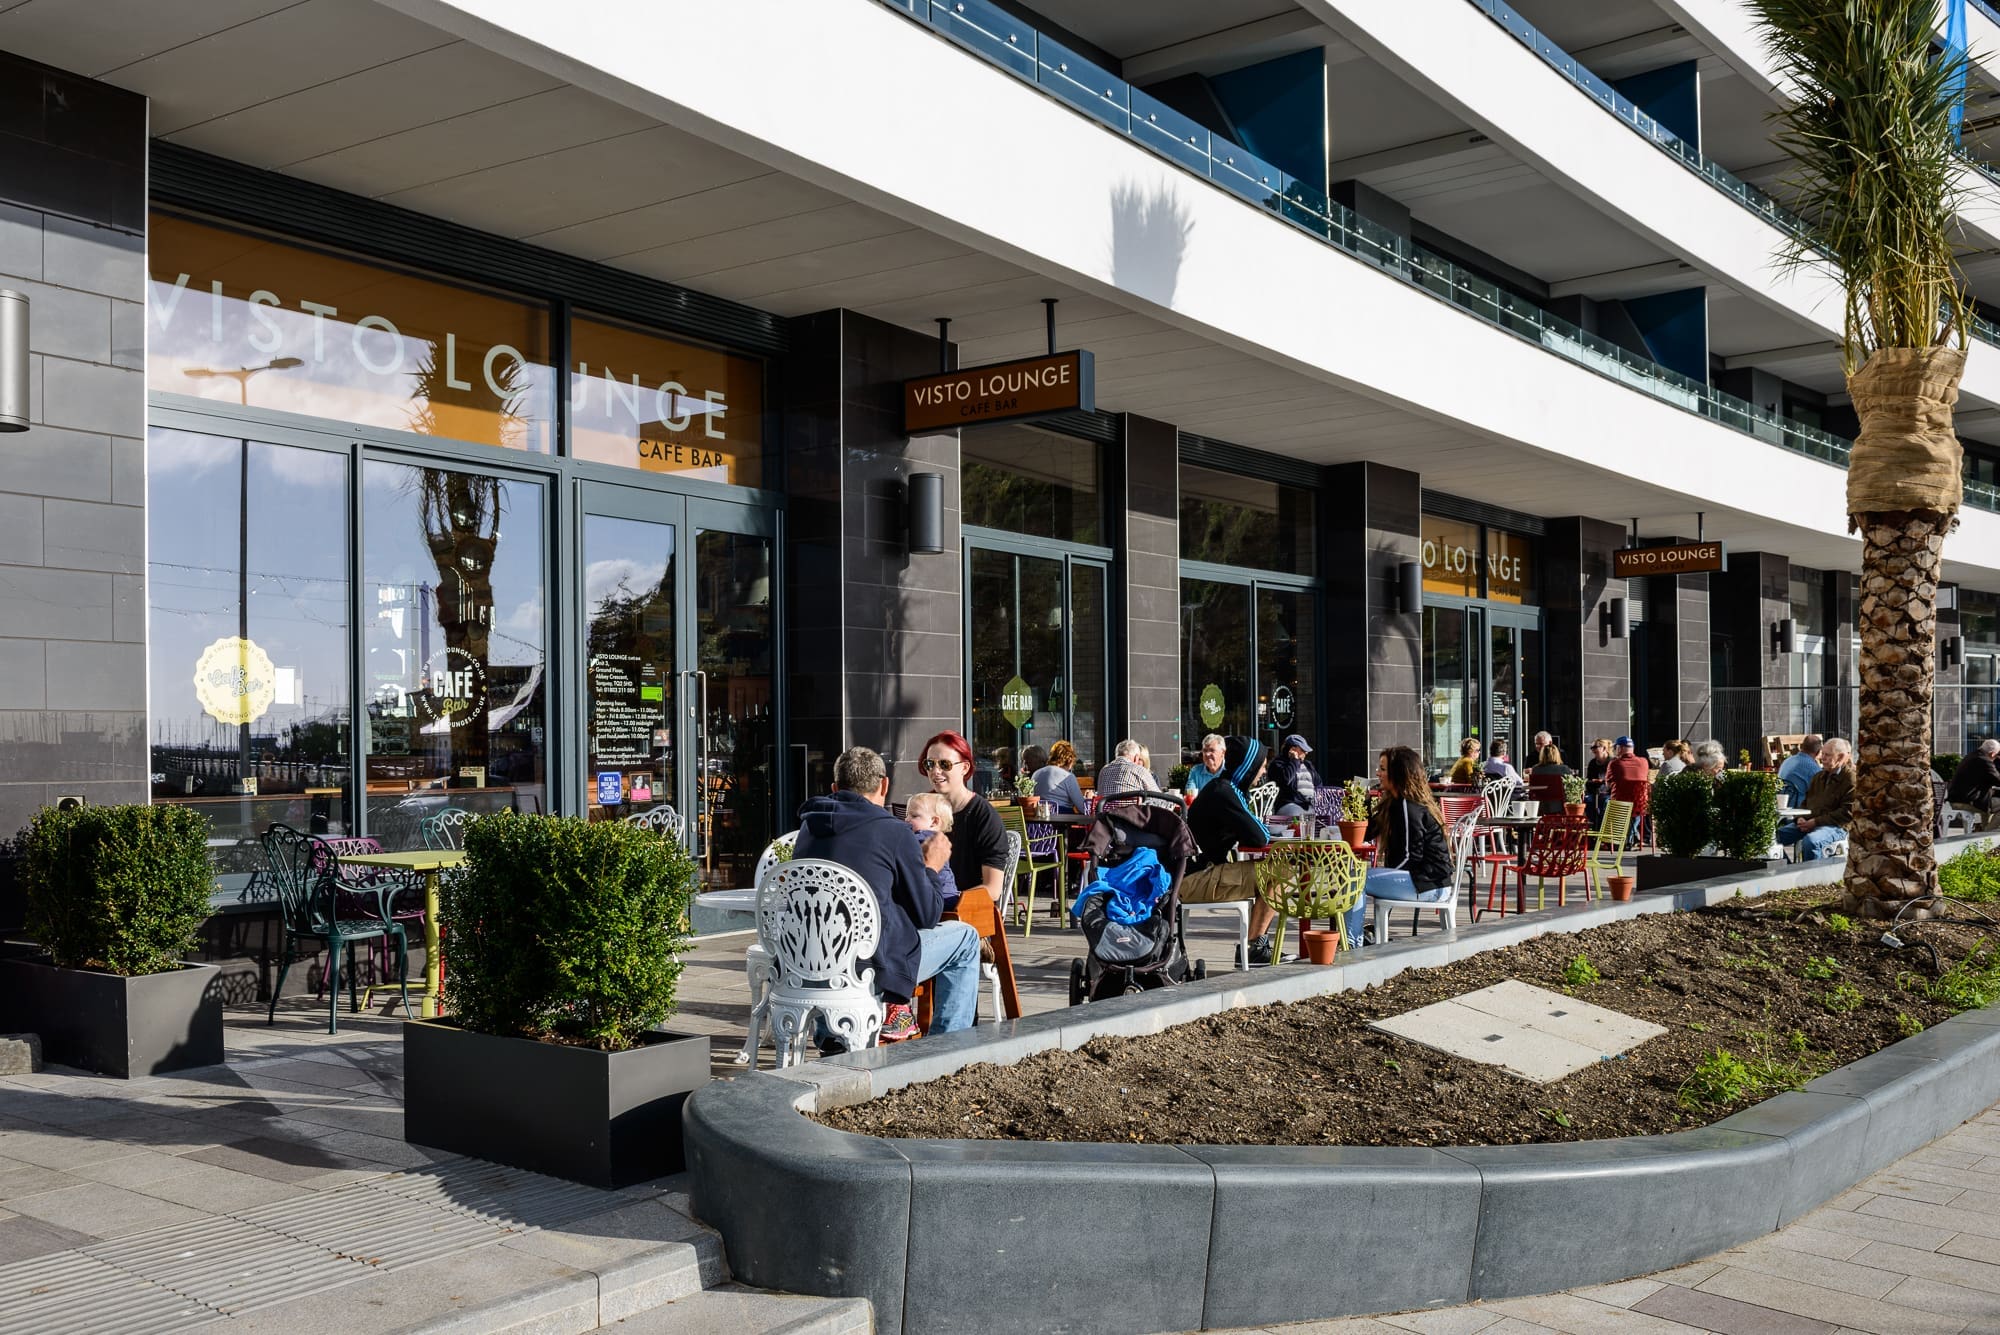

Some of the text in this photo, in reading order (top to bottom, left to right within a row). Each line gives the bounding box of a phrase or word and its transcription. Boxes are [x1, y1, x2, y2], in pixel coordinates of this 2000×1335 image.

[148, 272, 404, 375] VISTO
[914, 364, 1070, 406] VISTO LOUNGE
[995, 398, 1018, 411] BAR
[638, 439, 723, 468] CAFÉ BAR
[1620, 548, 1716, 564] VISTO LOUNGE
[232, 678, 264, 698] Bar
[433, 665, 474, 698] CAFÉ
[442, 698, 470, 716] Bar
[1002, 691, 1032, 710] CAFÉ BAR
[1276, 695, 1291, 713] CAFÉ
[420, 694, 486, 728] WWW.THOUNGES.CO.UK
